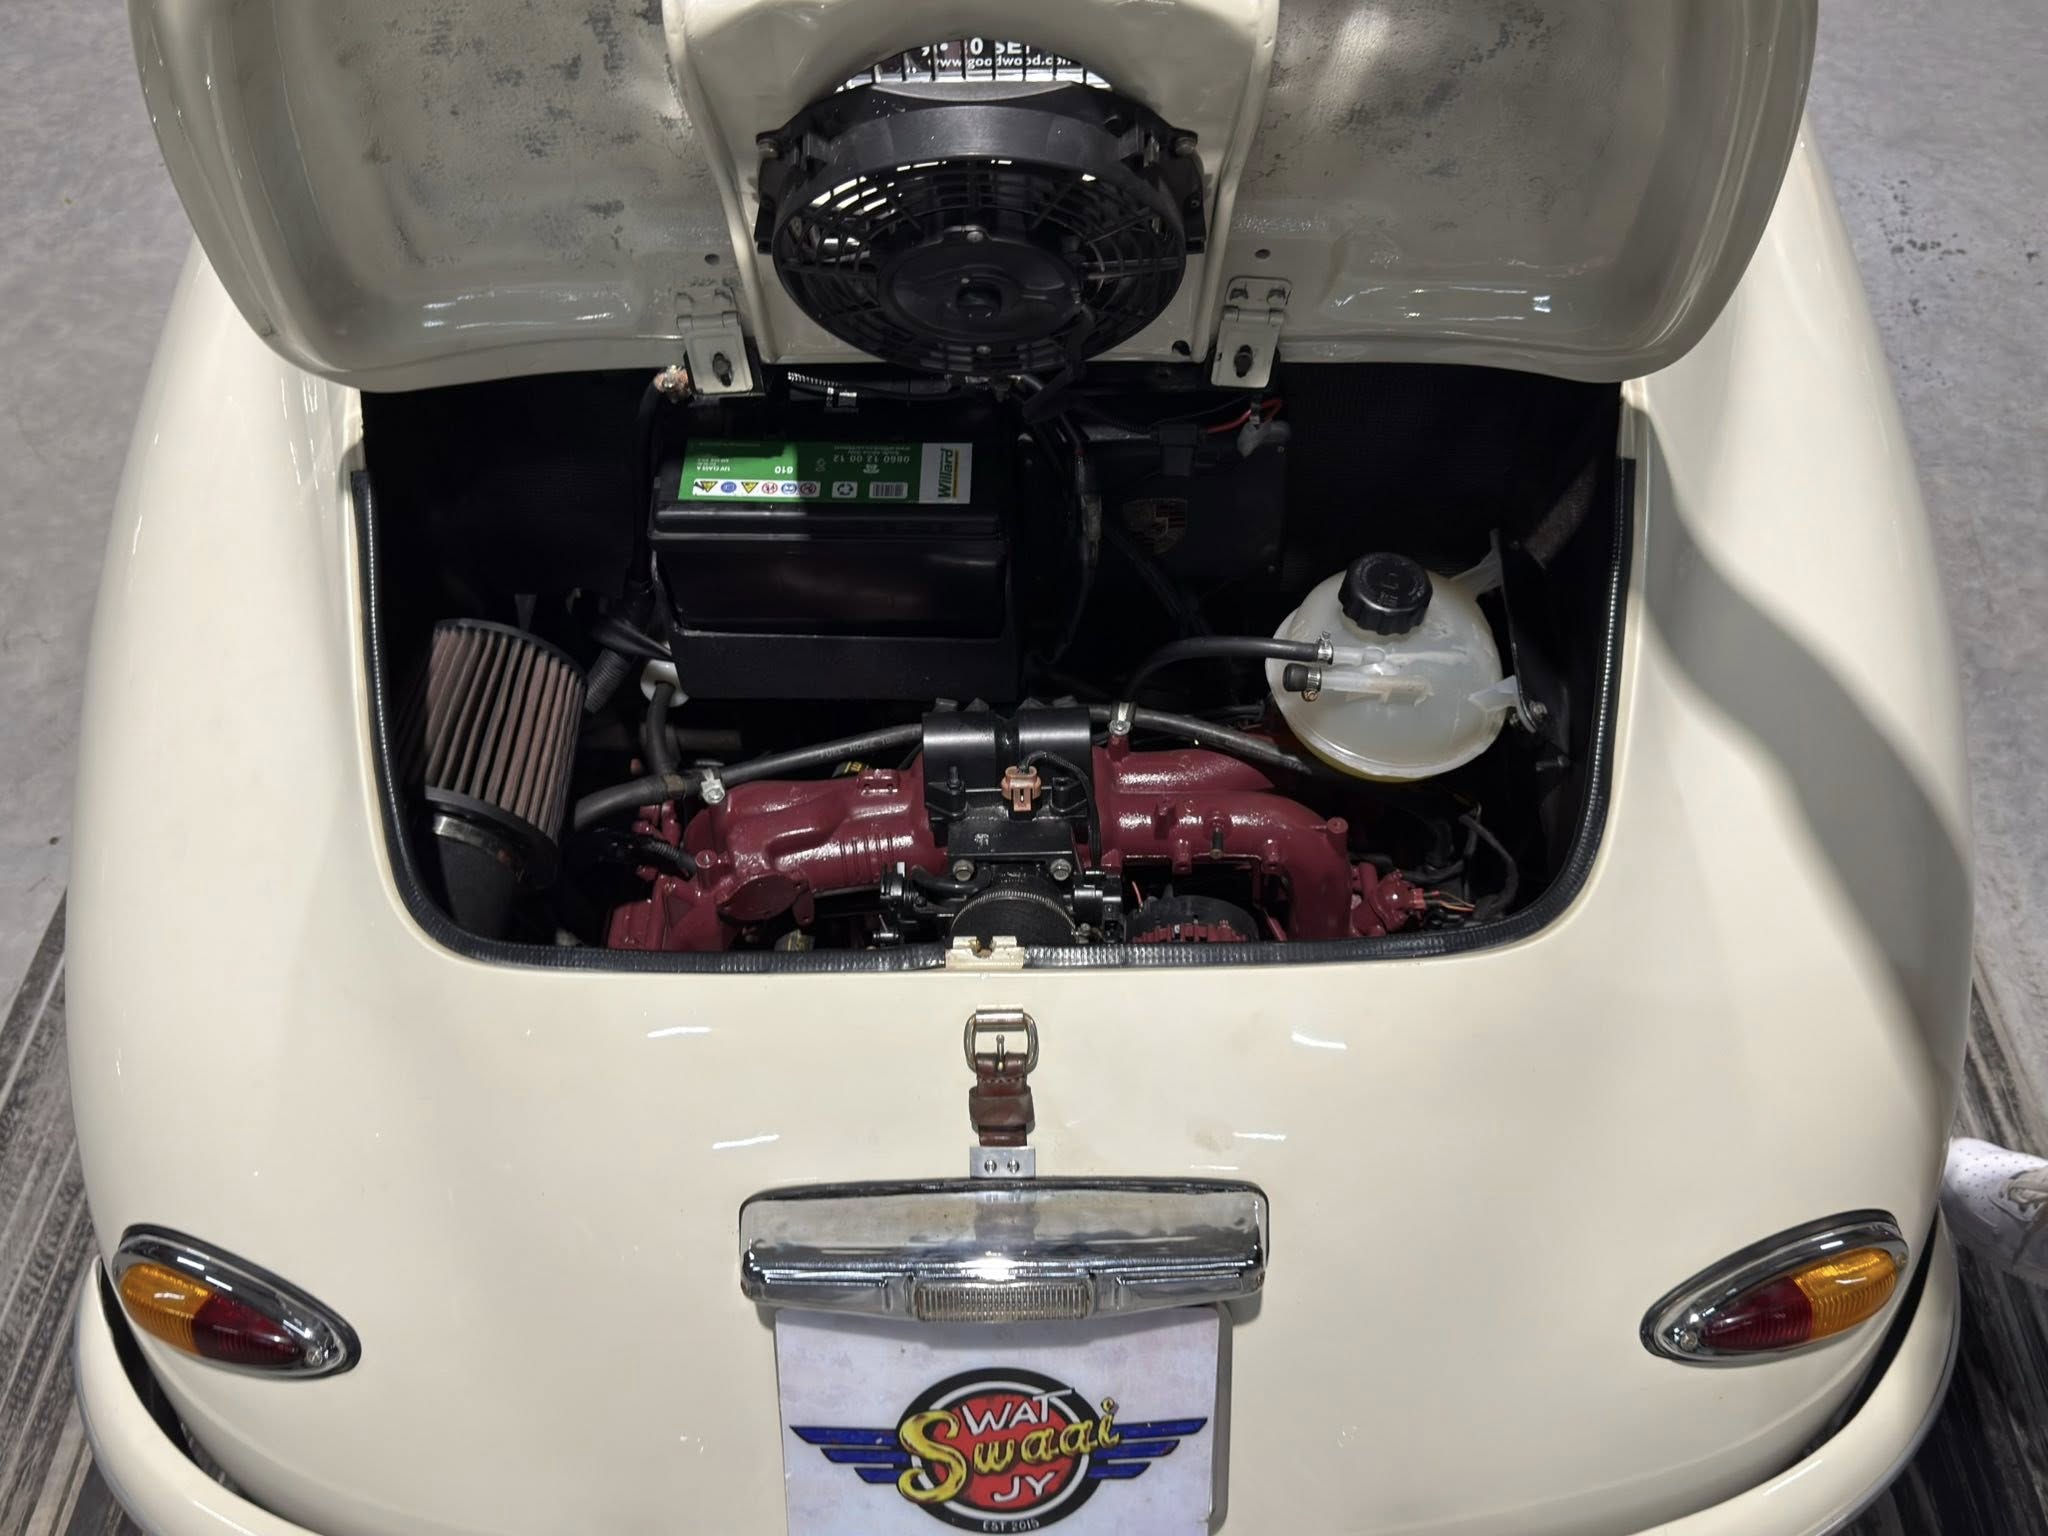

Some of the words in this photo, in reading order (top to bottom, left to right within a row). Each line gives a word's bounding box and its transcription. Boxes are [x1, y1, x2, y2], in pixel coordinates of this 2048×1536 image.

[774, 465, 794, 475] 610
[938, 448, 953, 498] Willard
[962, 1389, 1072, 1435] WAT
[898, 1397, 1119, 1503] Swaai
[993, 1471, 1055, 1502] JY
[983, 1519, 1006, 1532] EST
